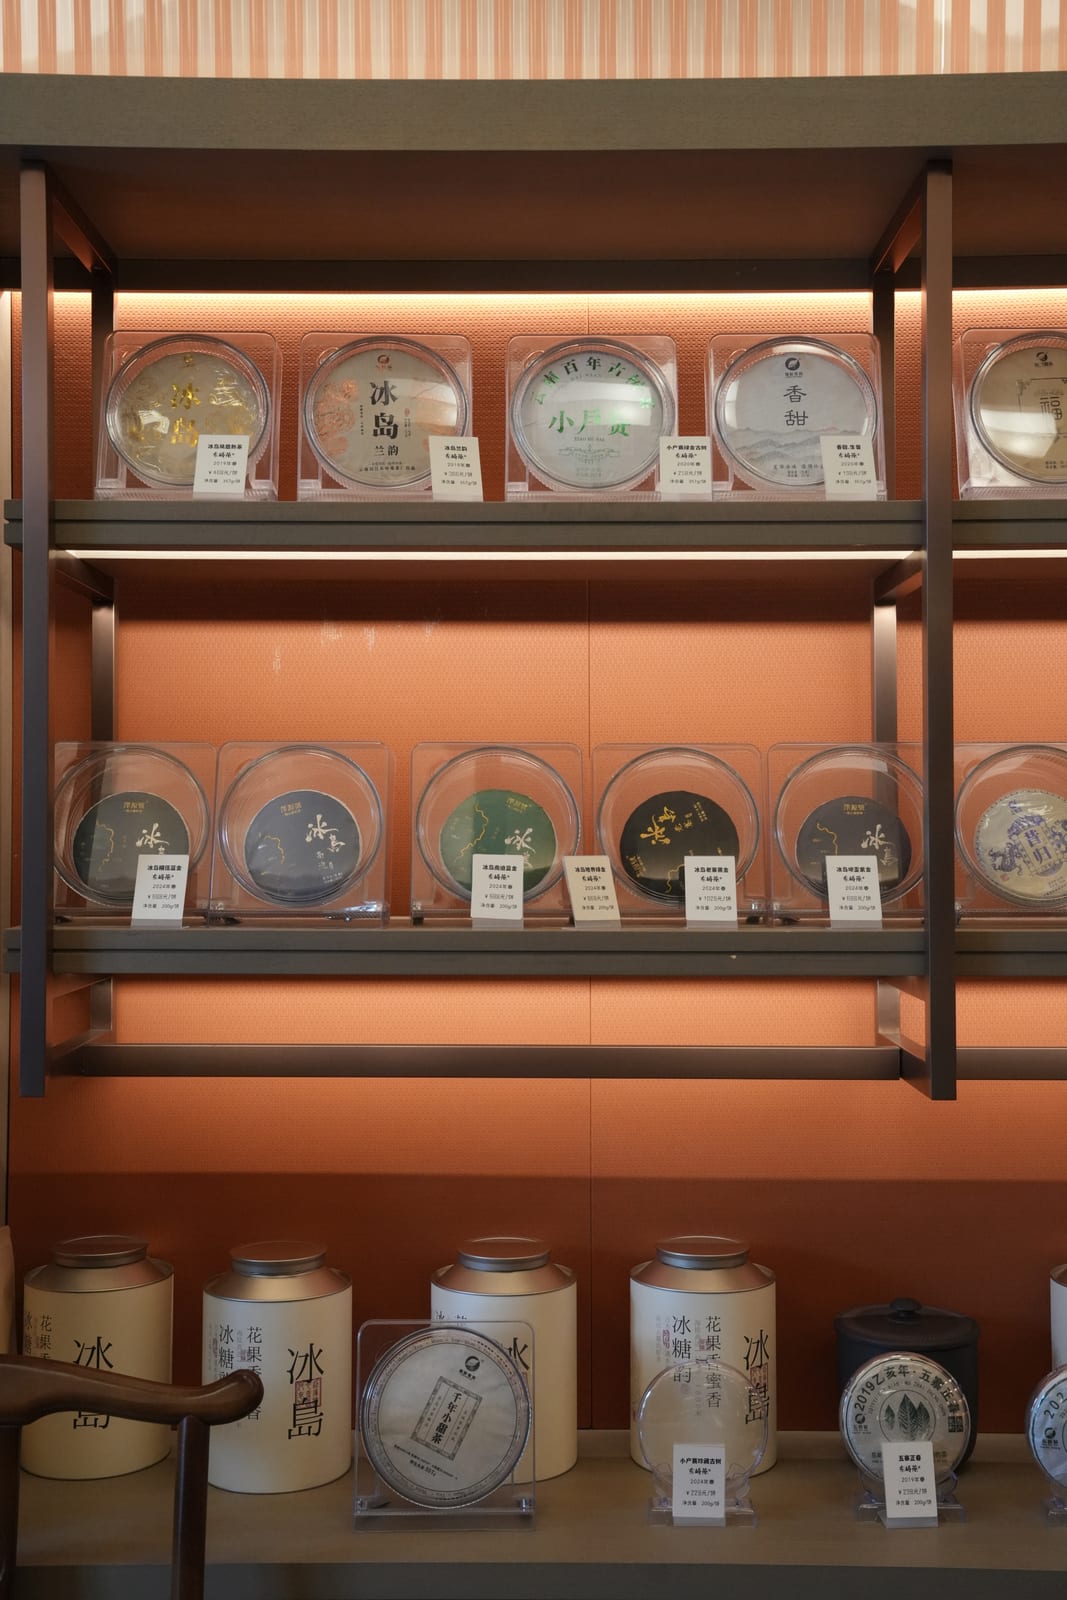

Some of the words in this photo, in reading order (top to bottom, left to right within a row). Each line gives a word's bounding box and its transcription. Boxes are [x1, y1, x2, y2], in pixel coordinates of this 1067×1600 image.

[370, 380, 399, 440] 冰岛
[783, 384, 808, 427] 香甜
[374, 444, 399, 457] 兰韵
[40, 1314, 52, 1359] 花果
[672, 1315, 692, 1384] 冰糖韵
[286, 1342, 325, 1440] 冰島
[431, 1392, 462, 1445] 千年小甜茶
